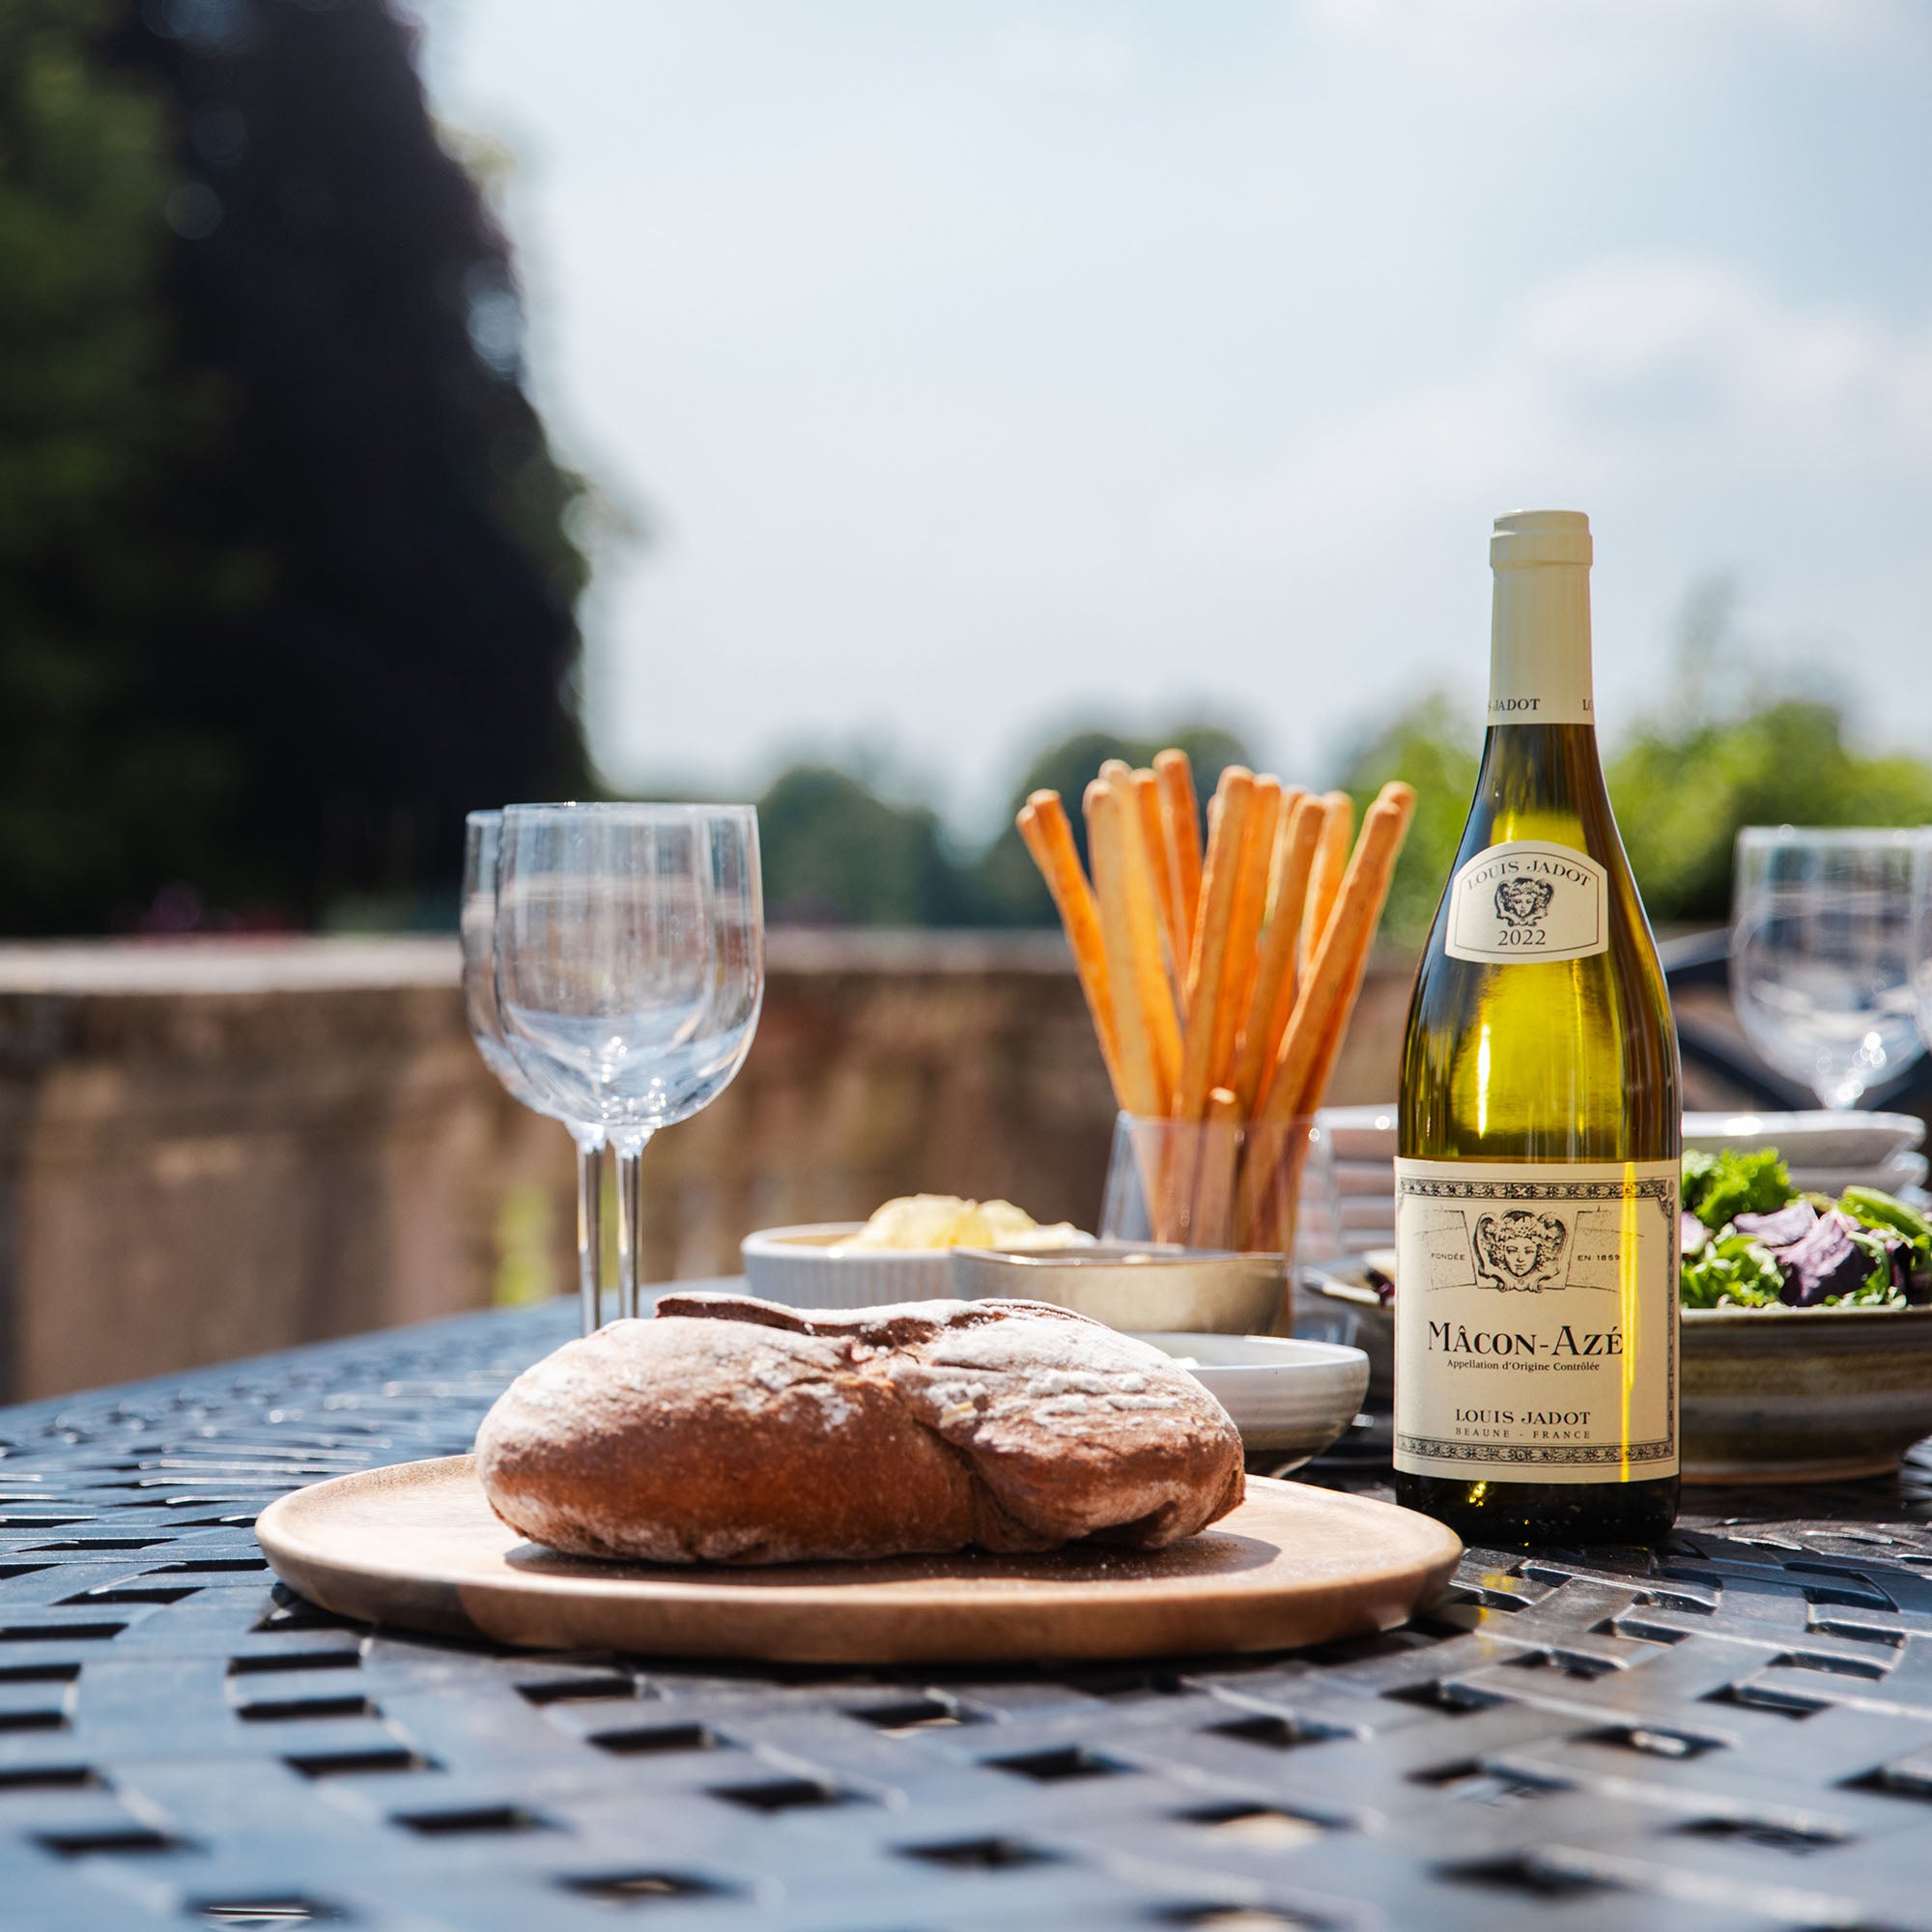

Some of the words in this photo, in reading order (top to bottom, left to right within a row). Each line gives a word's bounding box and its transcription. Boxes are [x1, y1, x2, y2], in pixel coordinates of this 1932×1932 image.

[1492, 697, 1541, 712] JADOT
[1467, 861, 1520, 890] LOUIS
[1526, 860, 1591, 888] JADOT
[1498, 929, 1547, 947] 2022
[1431, 1252, 1466, 1262] FONDÉE
[1447, 1359, 1499, 1371] Appellation
[1502, 1361, 1550, 1373] d'Origine
[1553, 1362, 1601, 1372] Contrôlée
[1456, 1408, 1515, 1425] LOUIS
[1520, 1411, 1591, 1425] JADOT
[1455, 1428, 1510, 1438] BEAUNE
[1533, 1430, 1590, 1439] FRANCE
